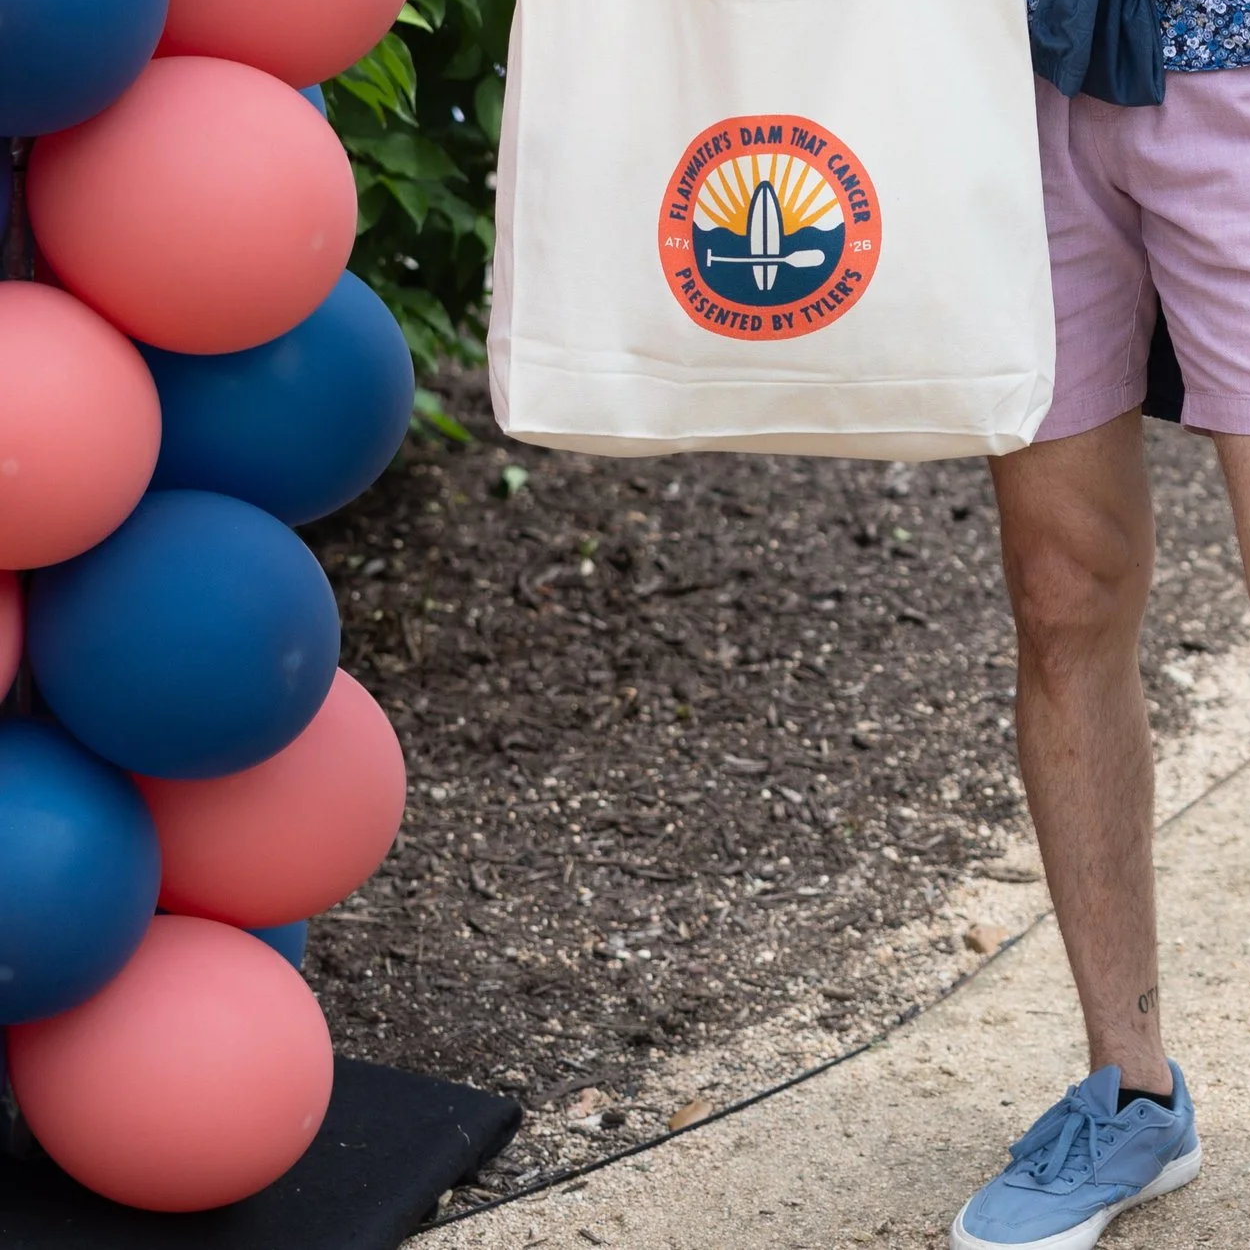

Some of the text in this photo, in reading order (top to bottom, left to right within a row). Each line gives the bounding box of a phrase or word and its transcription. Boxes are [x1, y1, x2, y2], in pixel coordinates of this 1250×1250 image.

[669, 125, 871, 225] FLATWATER'S DAM THAT CANCER
[664, 236, 690, 250] ATX
[675, 267, 862, 332] PRESENTED BY TYLER'S
